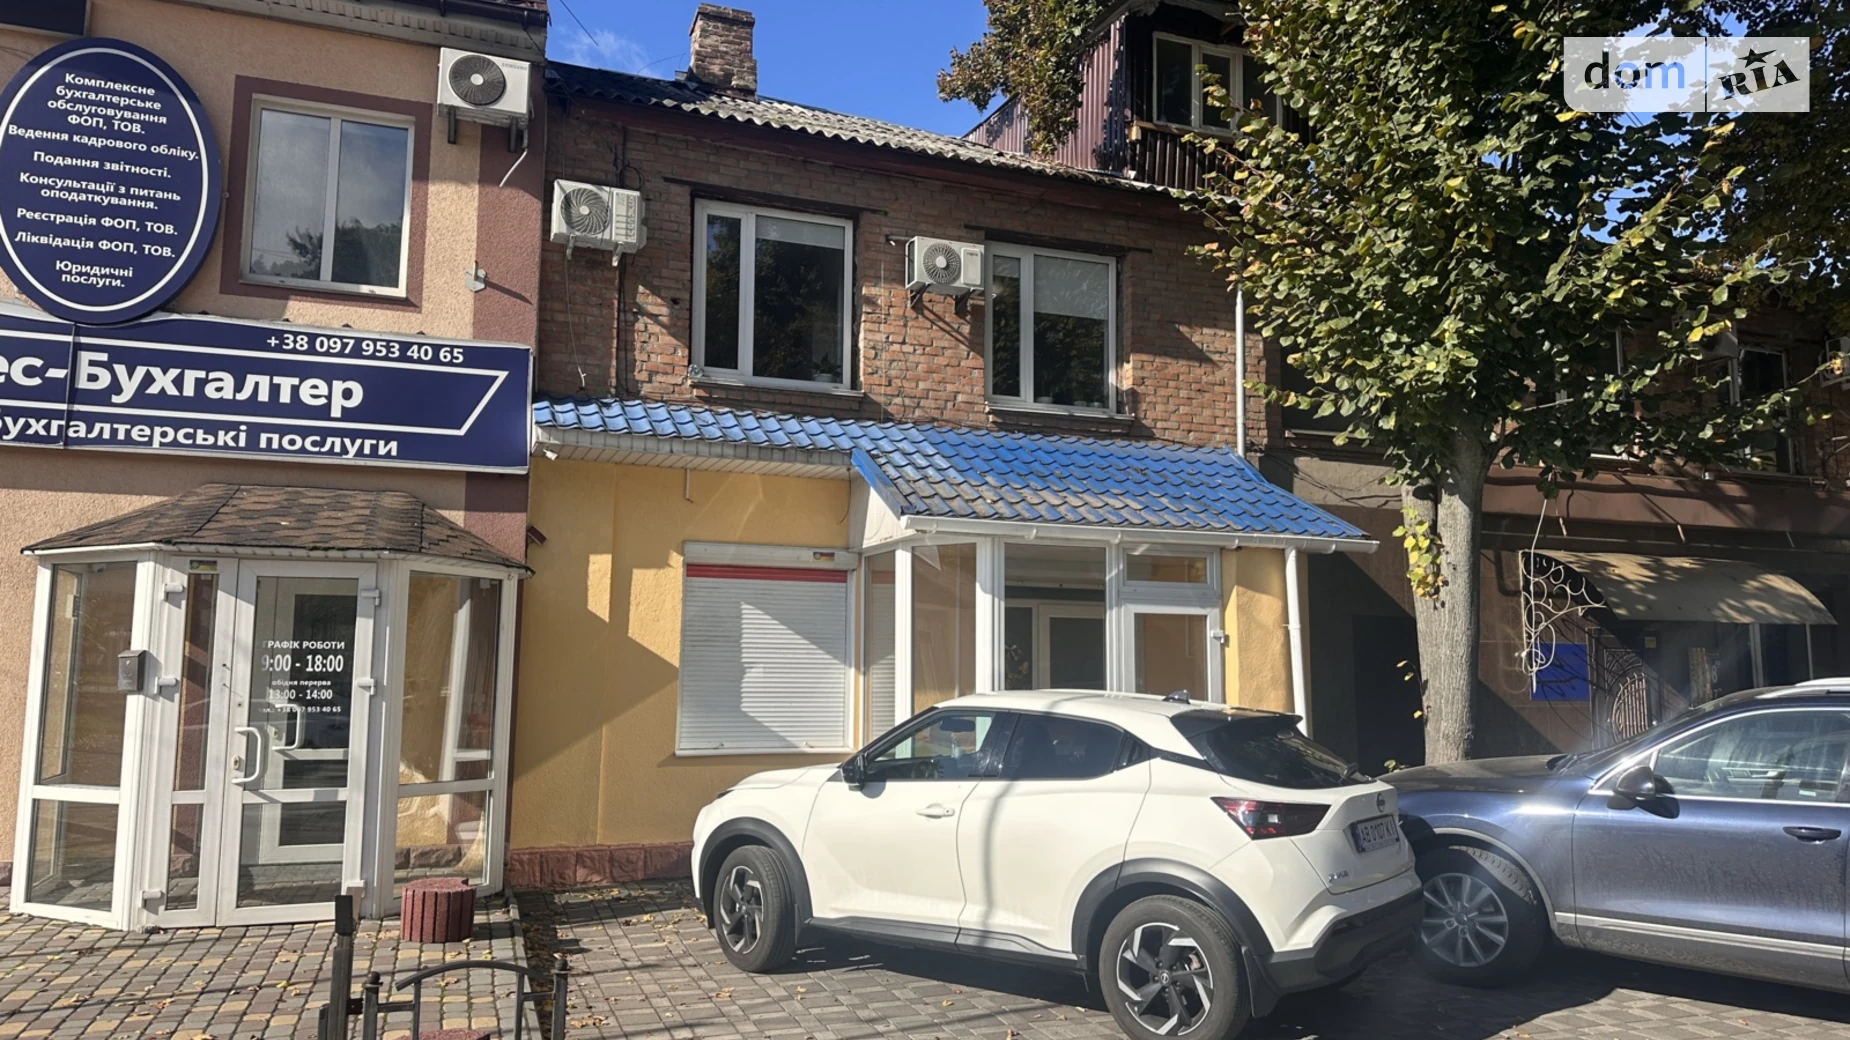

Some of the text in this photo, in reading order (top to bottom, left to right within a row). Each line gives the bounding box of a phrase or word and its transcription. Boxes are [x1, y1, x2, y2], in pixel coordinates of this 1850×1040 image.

[65, 73, 156, 96] Комплексне
[56, 85, 162, 111] бухгалтерське
[47, 99, 167, 125] обслуговування
[67, 114, 146, 135] ФОП, ТОВ.
[8, 124, 200, 161] Ведення кадрового обліку.
[33, 151, 172, 178] Подання звітності.
[19, 171, 182, 202] Консультації з питань
[40, 188, 159, 210] оподаткування.
[17, 207, 179, 235] Реєстрація ФОП, ТОВ.
[15, 231, 176, 258] Ліквідація ФОП, ТОВ.
[55, 259, 134, 278] Юридичні
[61, 272, 126, 288] послуги.
[266, 334, 466, 364] +38 097 953 40 65
[0, 350, 365, 417] с-Бухгалтер
[0, 411, 399, 460] ухгалтерські послуги
[263, 640, 345, 650] ГРАФІК РОБОТИ
[261, 654, 292, 672] 9:00
[305, 654, 344, 672] 18:00
[268, 689, 296, 700] 13:00
[305, 689, 333, 700] 14:00
[272, 678, 331, 688] обідня перерва
[307, 705, 321, 713] 953
[322, 705, 332, 713] 40
[332, 705, 342, 713] 65
